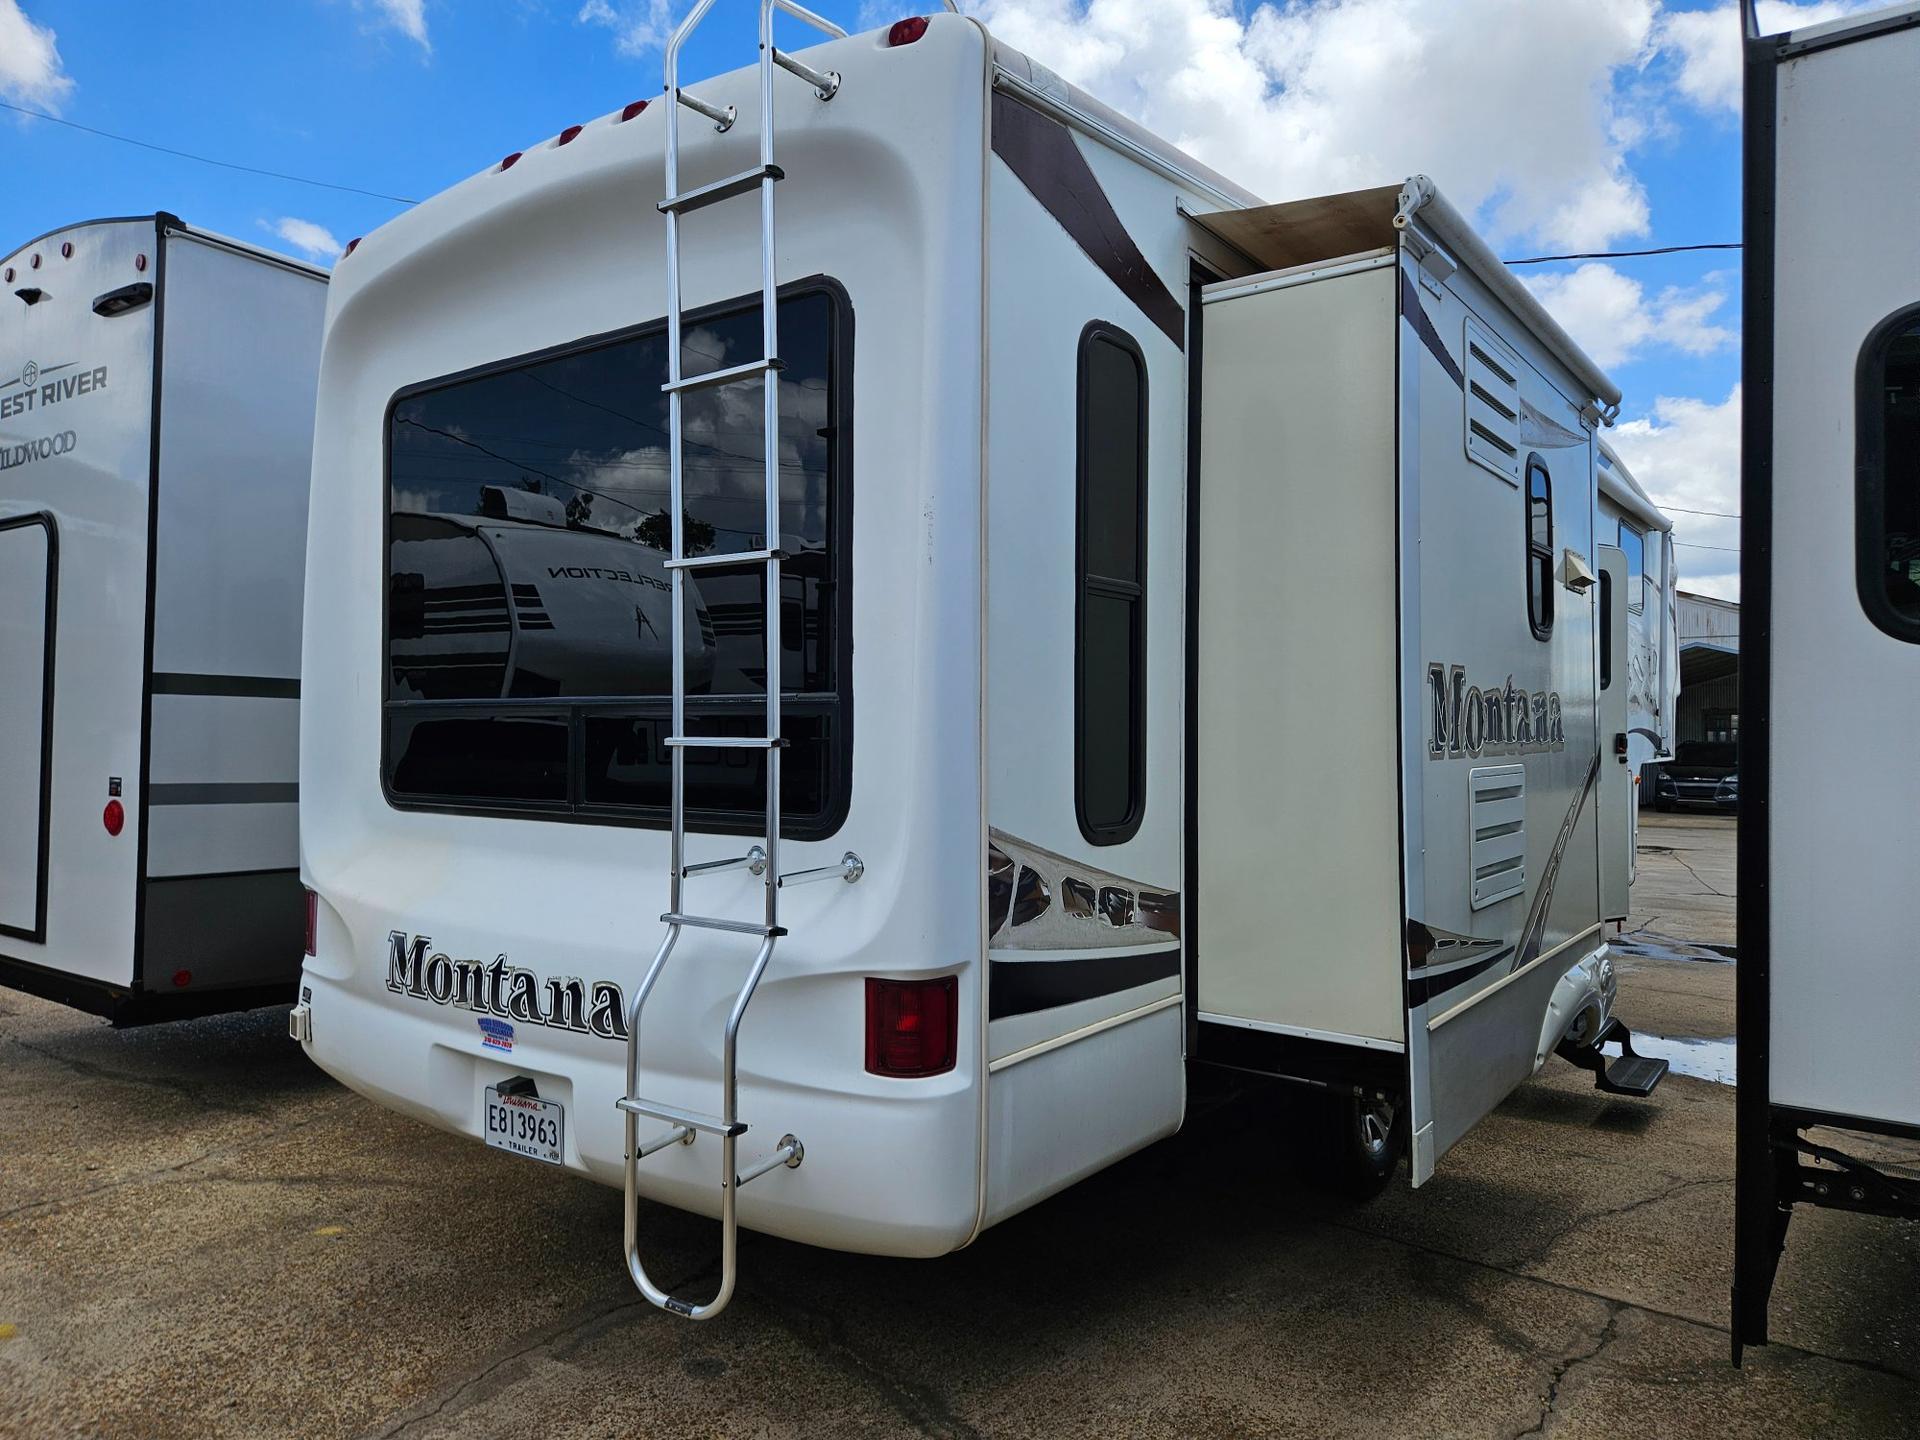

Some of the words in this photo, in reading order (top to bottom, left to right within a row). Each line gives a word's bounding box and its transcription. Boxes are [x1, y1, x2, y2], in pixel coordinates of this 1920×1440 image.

[41, 366, 107, 406] RIVER
[0, 430, 77, 471] ILDWOOD
[1427, 662, 1565, 761] Montana
[386, 930, 628, 1041] Montana
[489, 1104, 557, 1148] E813963
[508, 1140, 538, 1155] TRAILER
